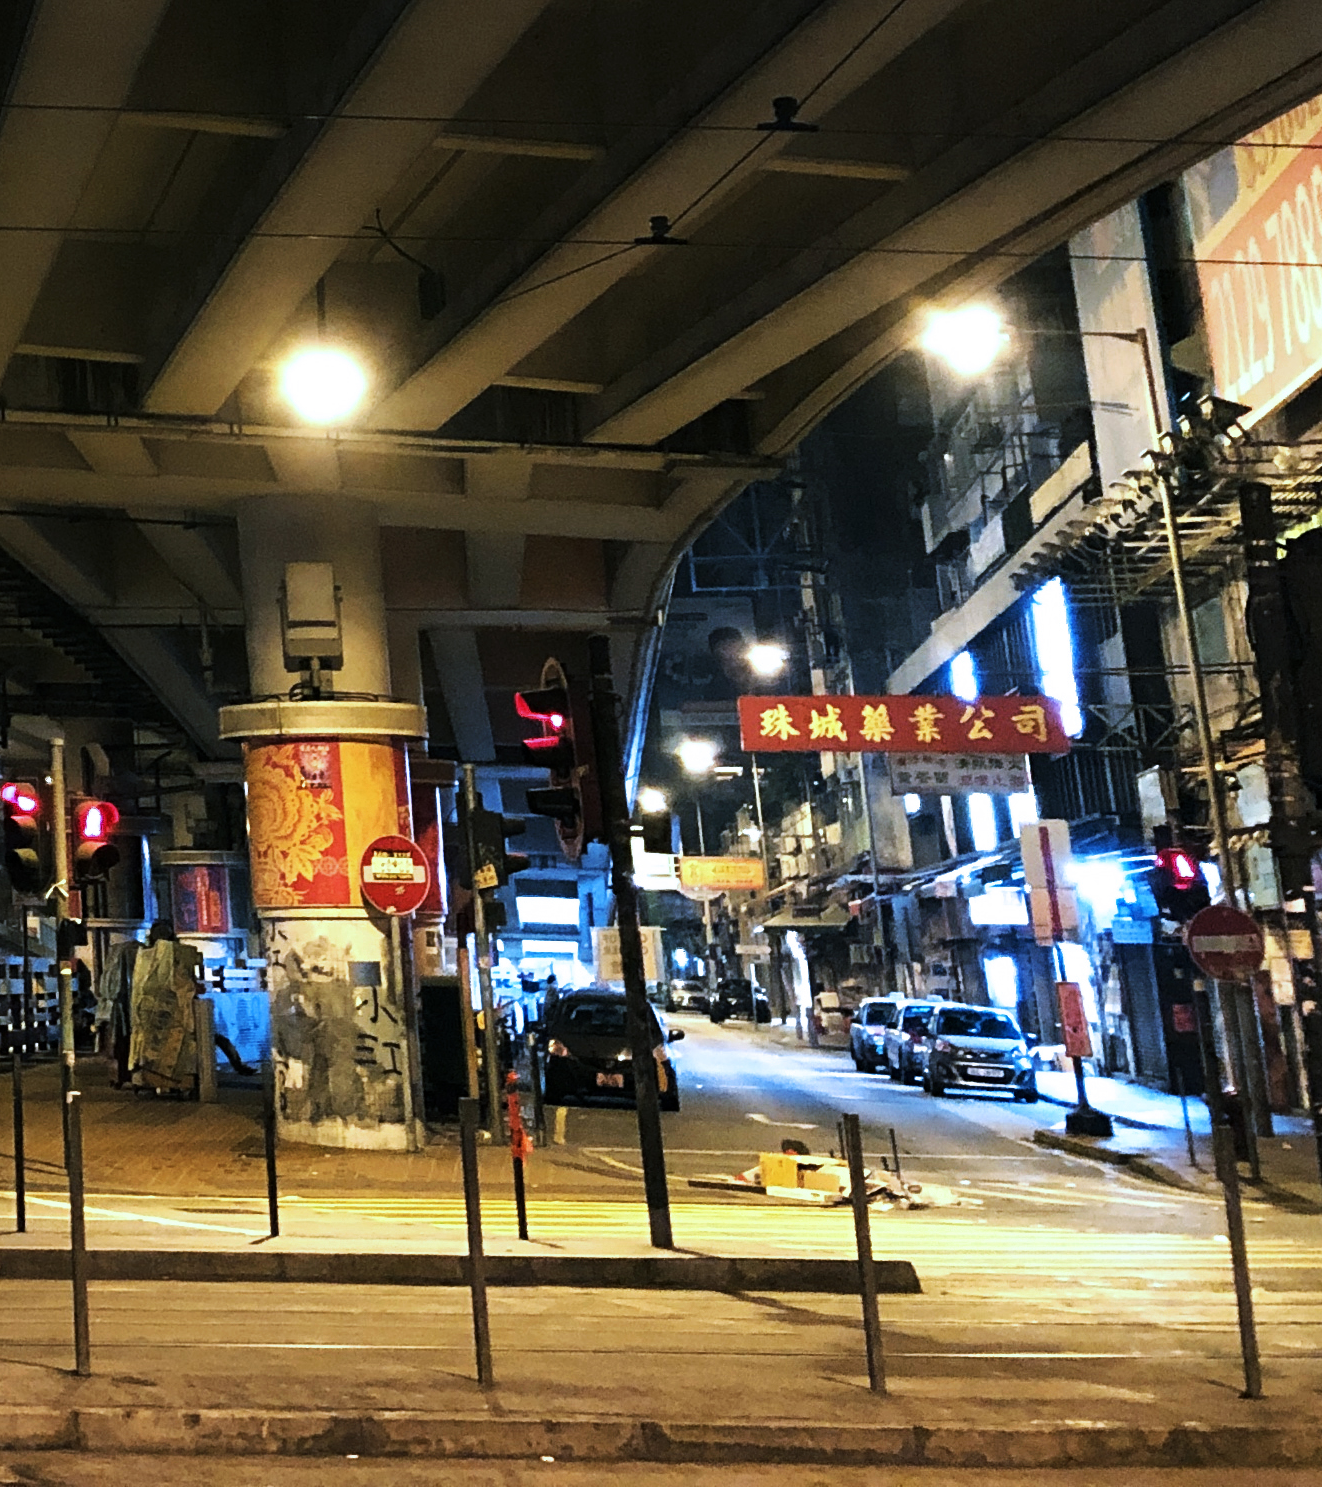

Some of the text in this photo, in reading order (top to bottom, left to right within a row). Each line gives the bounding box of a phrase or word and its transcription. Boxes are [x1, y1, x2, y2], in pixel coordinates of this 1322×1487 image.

[760, 703, 1047, 743] 珠城藥業公司
[355, 986, 403, 1076] 小江
